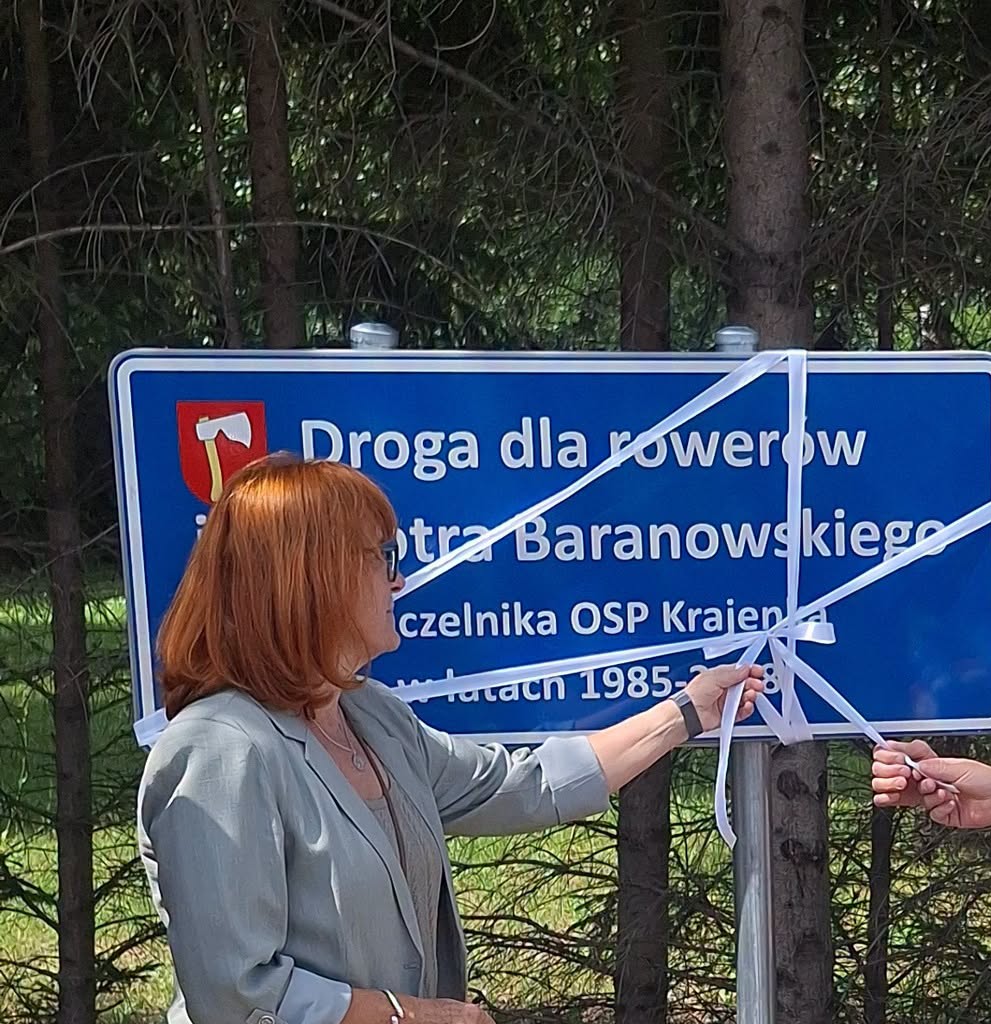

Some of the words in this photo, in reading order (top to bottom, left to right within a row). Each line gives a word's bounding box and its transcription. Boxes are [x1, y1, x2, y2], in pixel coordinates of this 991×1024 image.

[301, 419, 480, 482] Droga
[500, 416, 587, 469] dla
[515, 507, 947, 567] Baranowskiego
[398, 600, 558, 638] czelnika
[570, 600, 650, 636] OSP
[662, 598, 828, 635] Krajena
[579, 663, 782, 699] 1985-8
